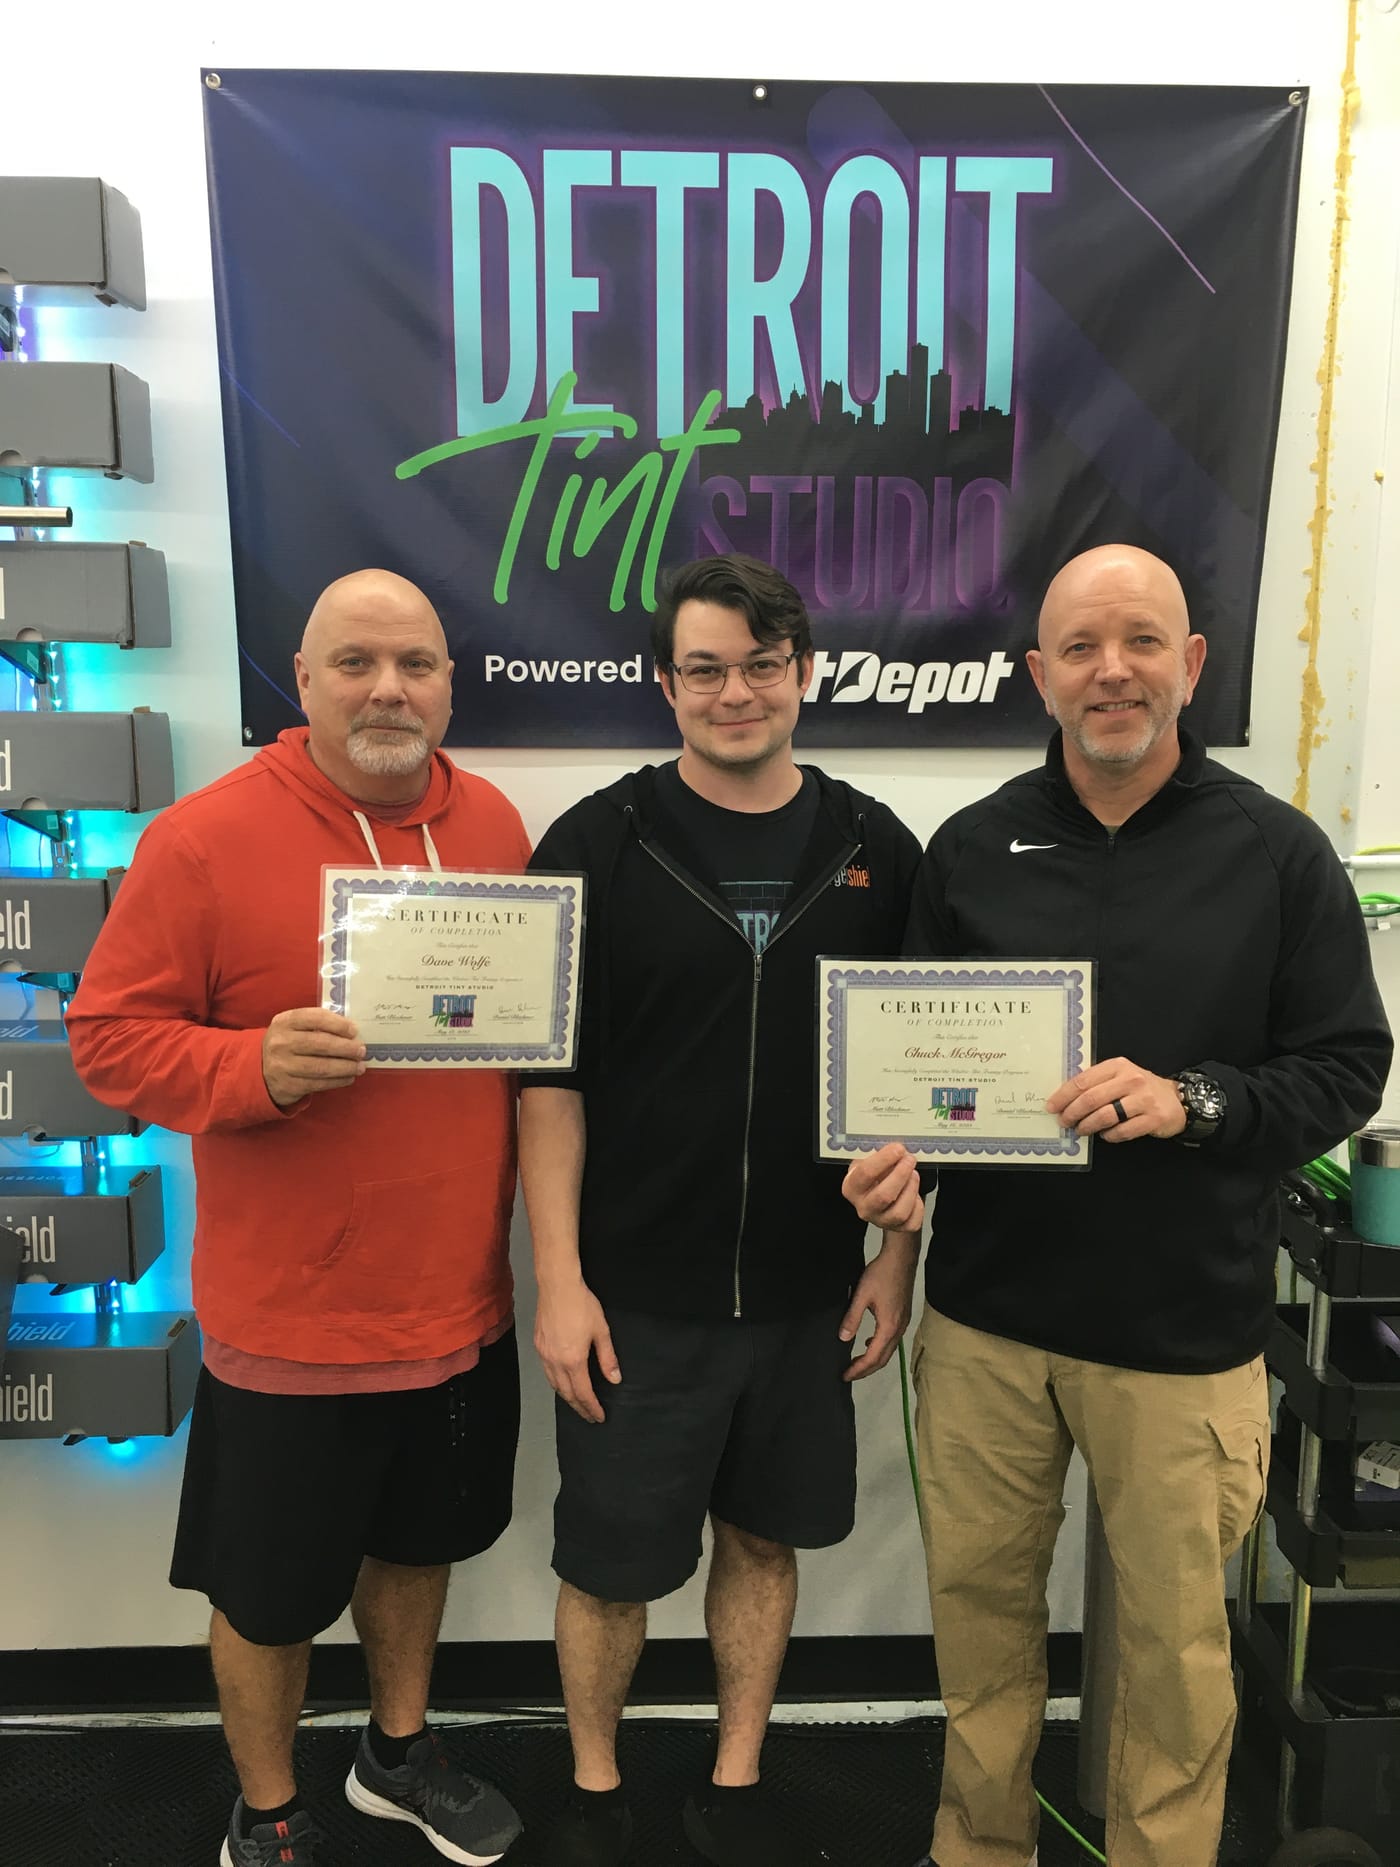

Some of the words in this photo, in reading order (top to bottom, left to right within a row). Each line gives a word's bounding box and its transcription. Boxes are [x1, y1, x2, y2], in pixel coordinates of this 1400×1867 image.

[449, 146, 1055, 440] DETROIT
[394, 370, 742, 613] Tint
[697, 474, 1013, 610] STUDIO
[484, 654, 643, 684] Powered
[385, 909, 528, 925] CERTIFICATE
[410, 927, 424, 935] OF
[430, 927, 503, 937] COMPLETION
[421, 954, 454, 968] Dave
[457, 954, 492, 971] Wolfe
[881, 1001, 1032, 1014] CERTIFICATE
[907, 1018, 922, 1027] OF
[927, 1018, 1004, 1028] COMPLETION
[904, 1046, 941, 1060] Chuck
[941, 1046, 1007, 1064] McGregor
